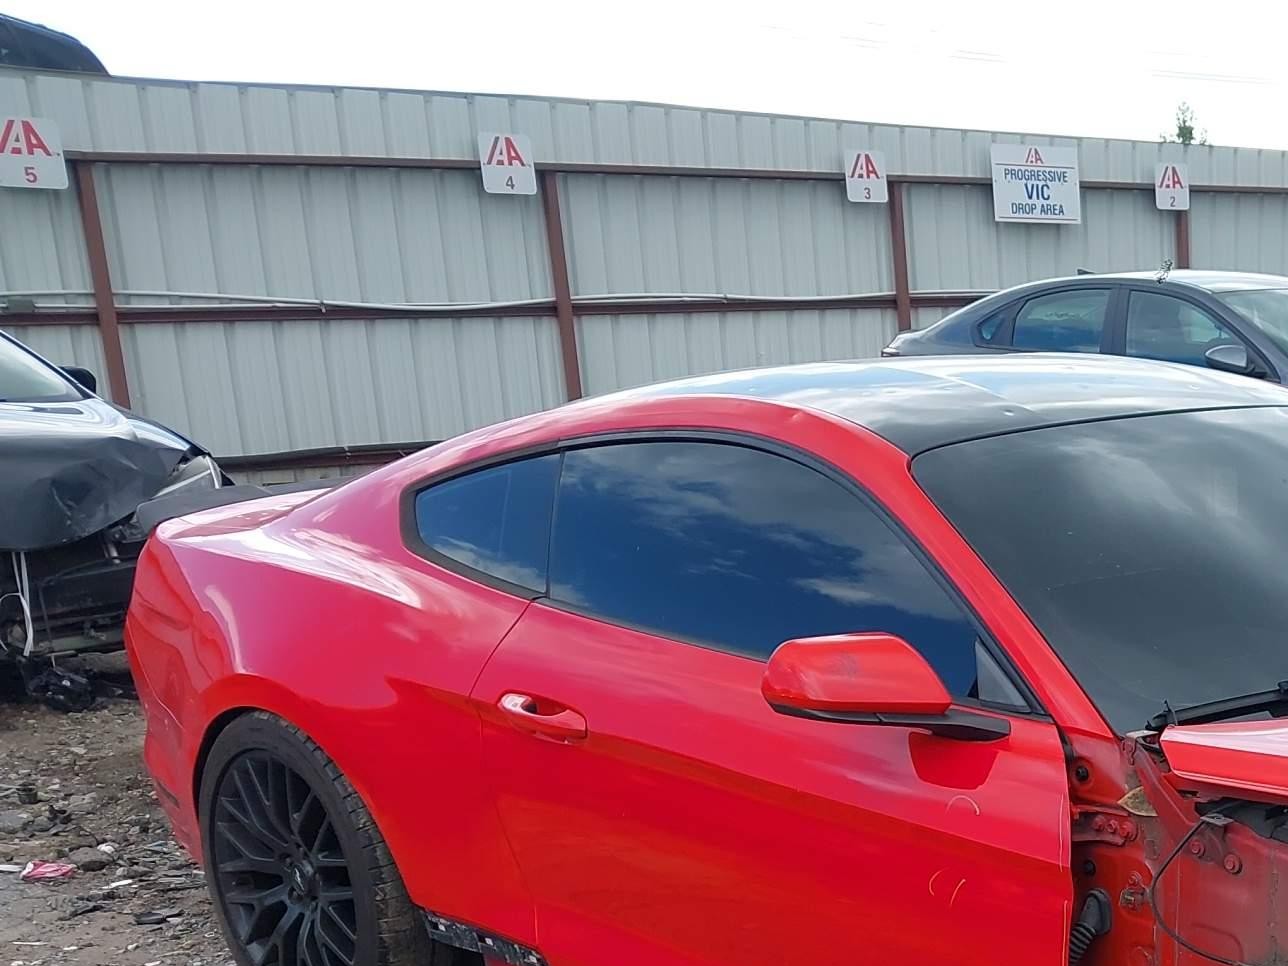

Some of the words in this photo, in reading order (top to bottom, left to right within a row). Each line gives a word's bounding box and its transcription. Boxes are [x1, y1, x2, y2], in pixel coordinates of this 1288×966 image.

[23, 166, 38, 184] 5
[505, 175, 516, 190] 4
[1004, 168, 1068, 183] PROGRESSIVE
[863, 187, 872, 200] 3
[1024, 183, 1051, 201] VIC
[1011, 202, 1037, 215] DROP
[1040, 203, 1065, 216] AREA
[1169, 196, 1176, 207] 2
